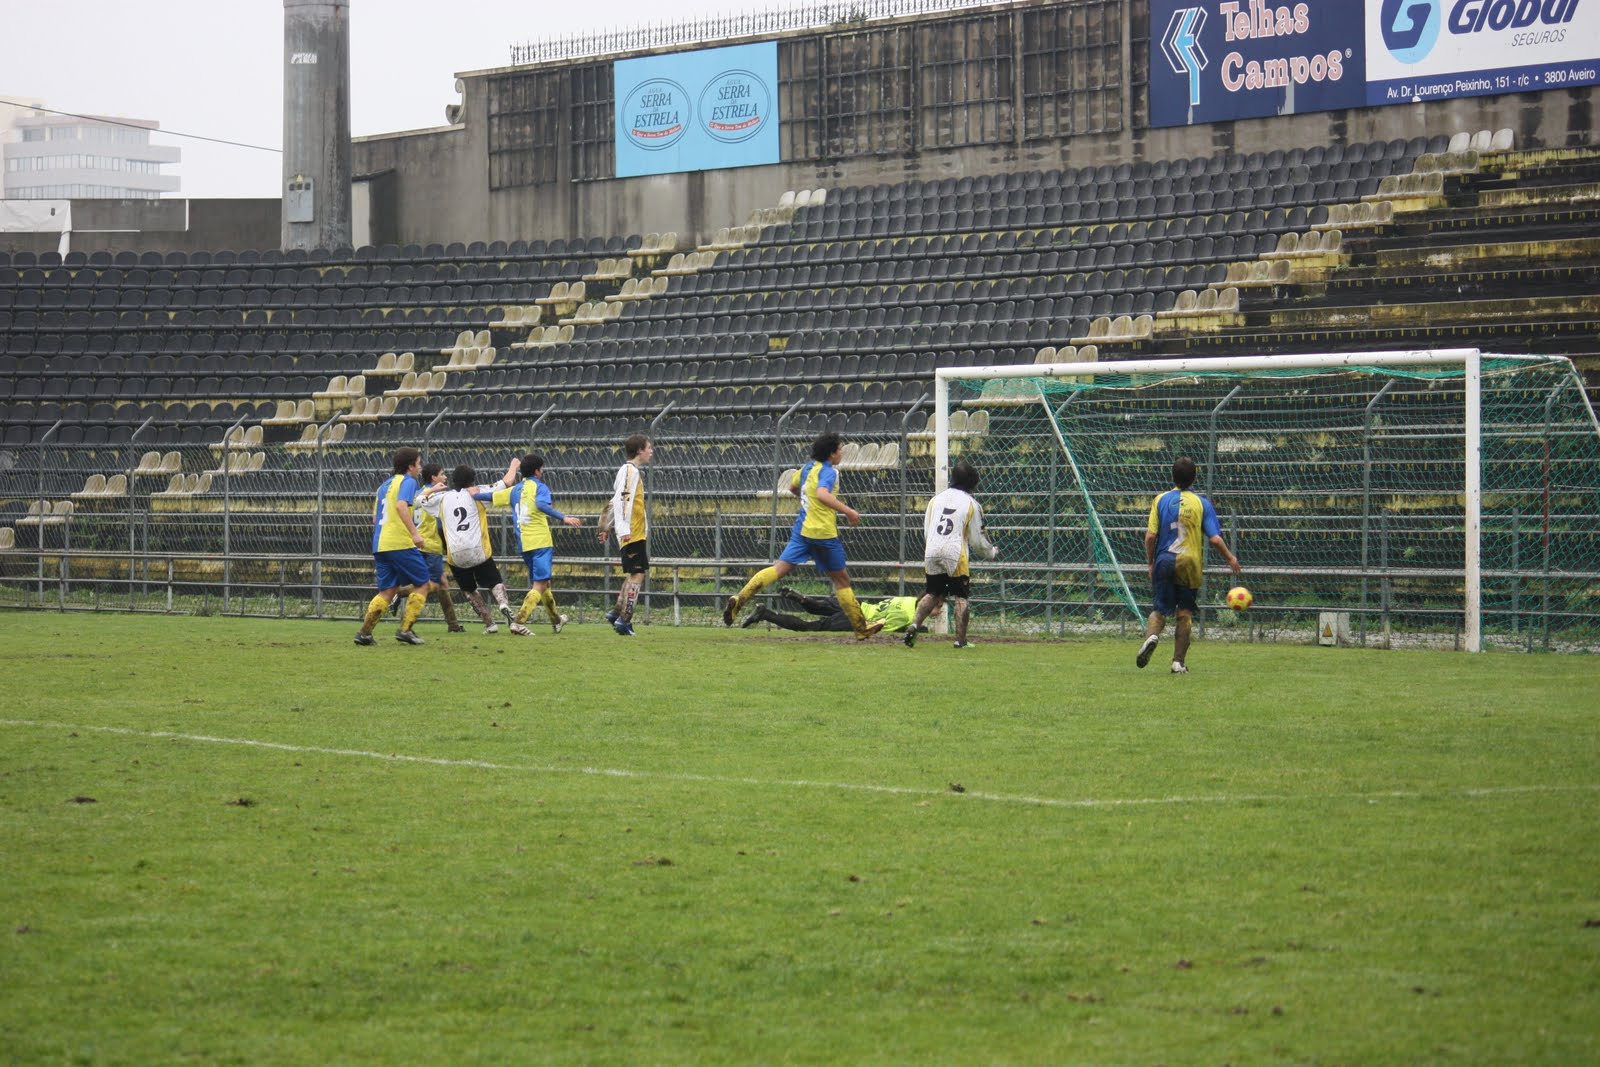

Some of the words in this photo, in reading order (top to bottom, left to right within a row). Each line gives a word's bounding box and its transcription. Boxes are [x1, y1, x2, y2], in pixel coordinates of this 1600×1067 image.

[1220, 0, 1309, 41] Telhas
[1511, 28, 1567, 47] SEGUROS
[1221, 50, 1343, 92] Campos
[718, 84, 750, 101] SERRA
[1387, 87, 1399, 98] Av.
[1401, 85, 1412, 97] Dr.
[1414, 83, 1453, 96] Lourenço
[1455, 78, 1492, 92] Peixinho,
[1495, 75, 1510, 88] 151
[1518, 73, 1530, 87] r/c
[1544, 70, 1567, 83] 3800
[1568, 68, 1596, 82] Aveiro
[640, 92, 671, 108] SERRA
[634, 110, 679, 128] ESTRELA
[711, 103, 758, 120] ESTRELA
[453, 506, 470, 532] 2
[937, 507, 957, 536] 5
